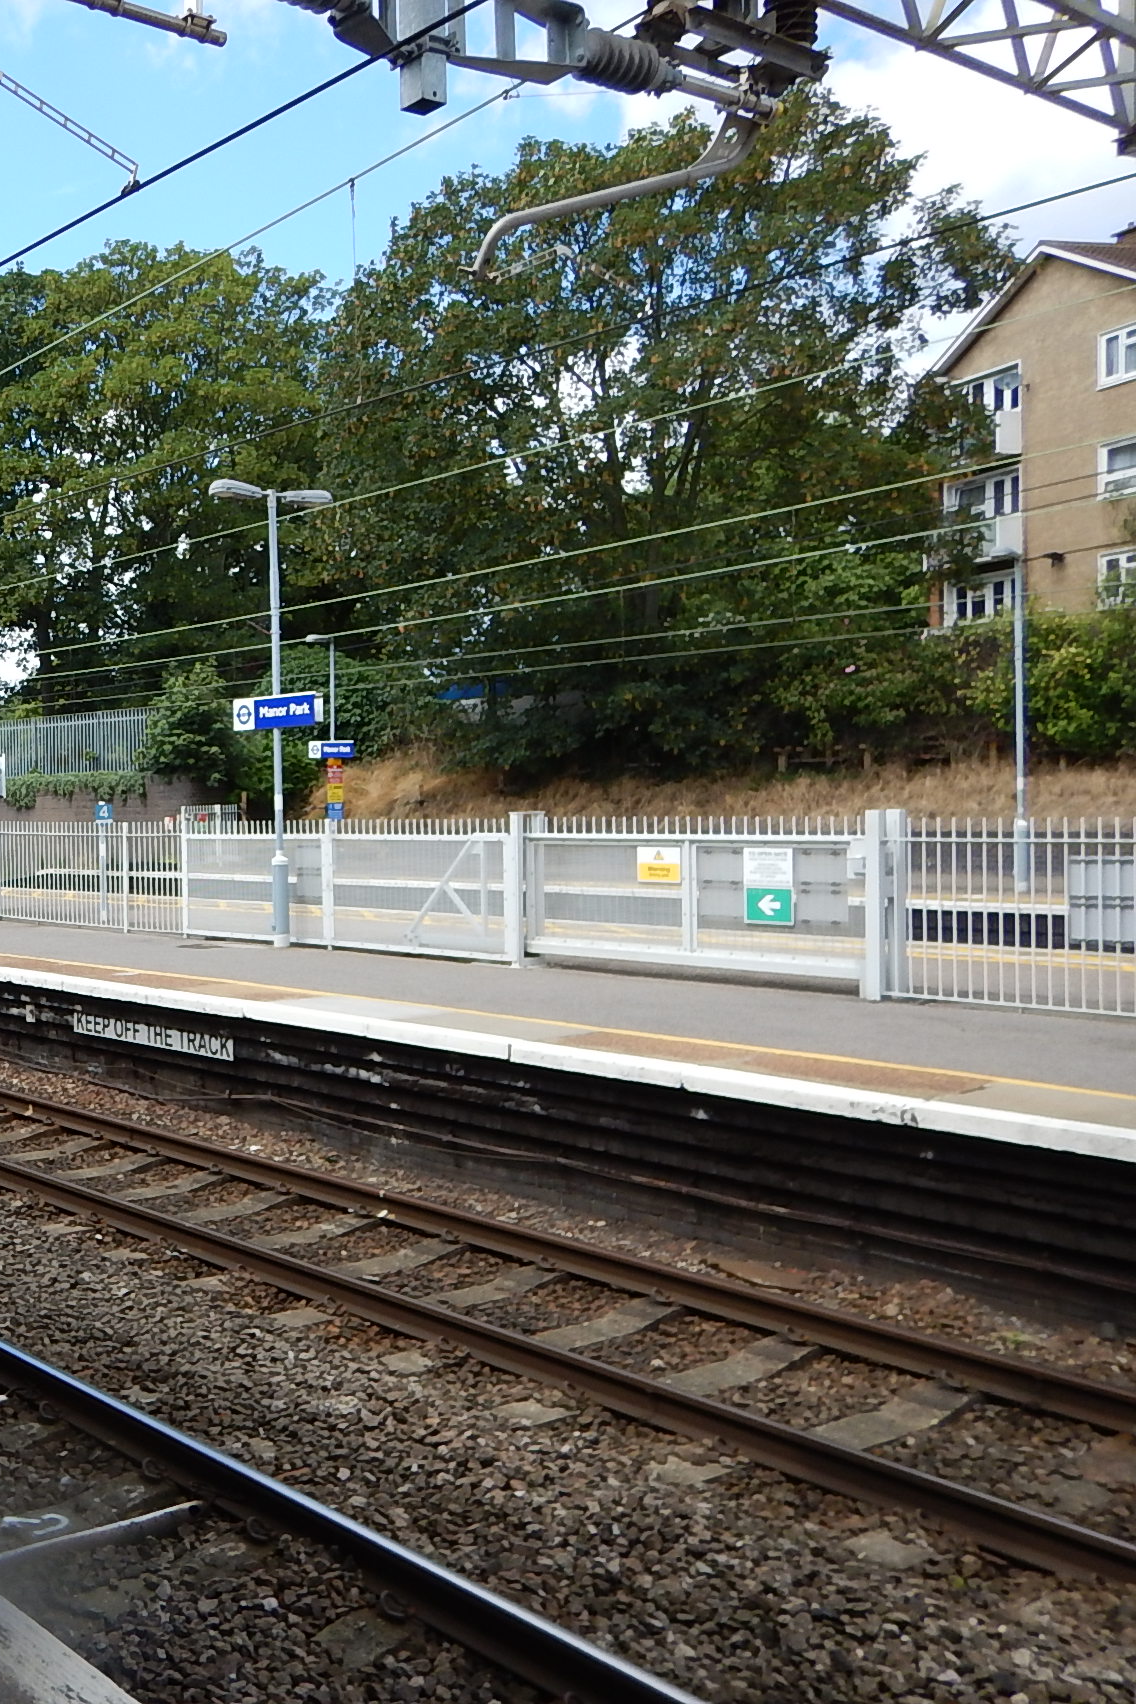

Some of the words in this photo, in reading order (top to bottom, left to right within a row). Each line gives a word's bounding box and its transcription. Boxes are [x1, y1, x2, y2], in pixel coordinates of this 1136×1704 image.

[259, 705, 287, 718] Manor
[289, 702, 310, 716] Park
[99, 805, 109, 818] 4
[76, 1012, 111, 1035] KEEP
[114, 1019, 141, 1041] OFF
[145, 1024, 174, 1047] THE
[179, 1029, 231, 1058] TRACK
